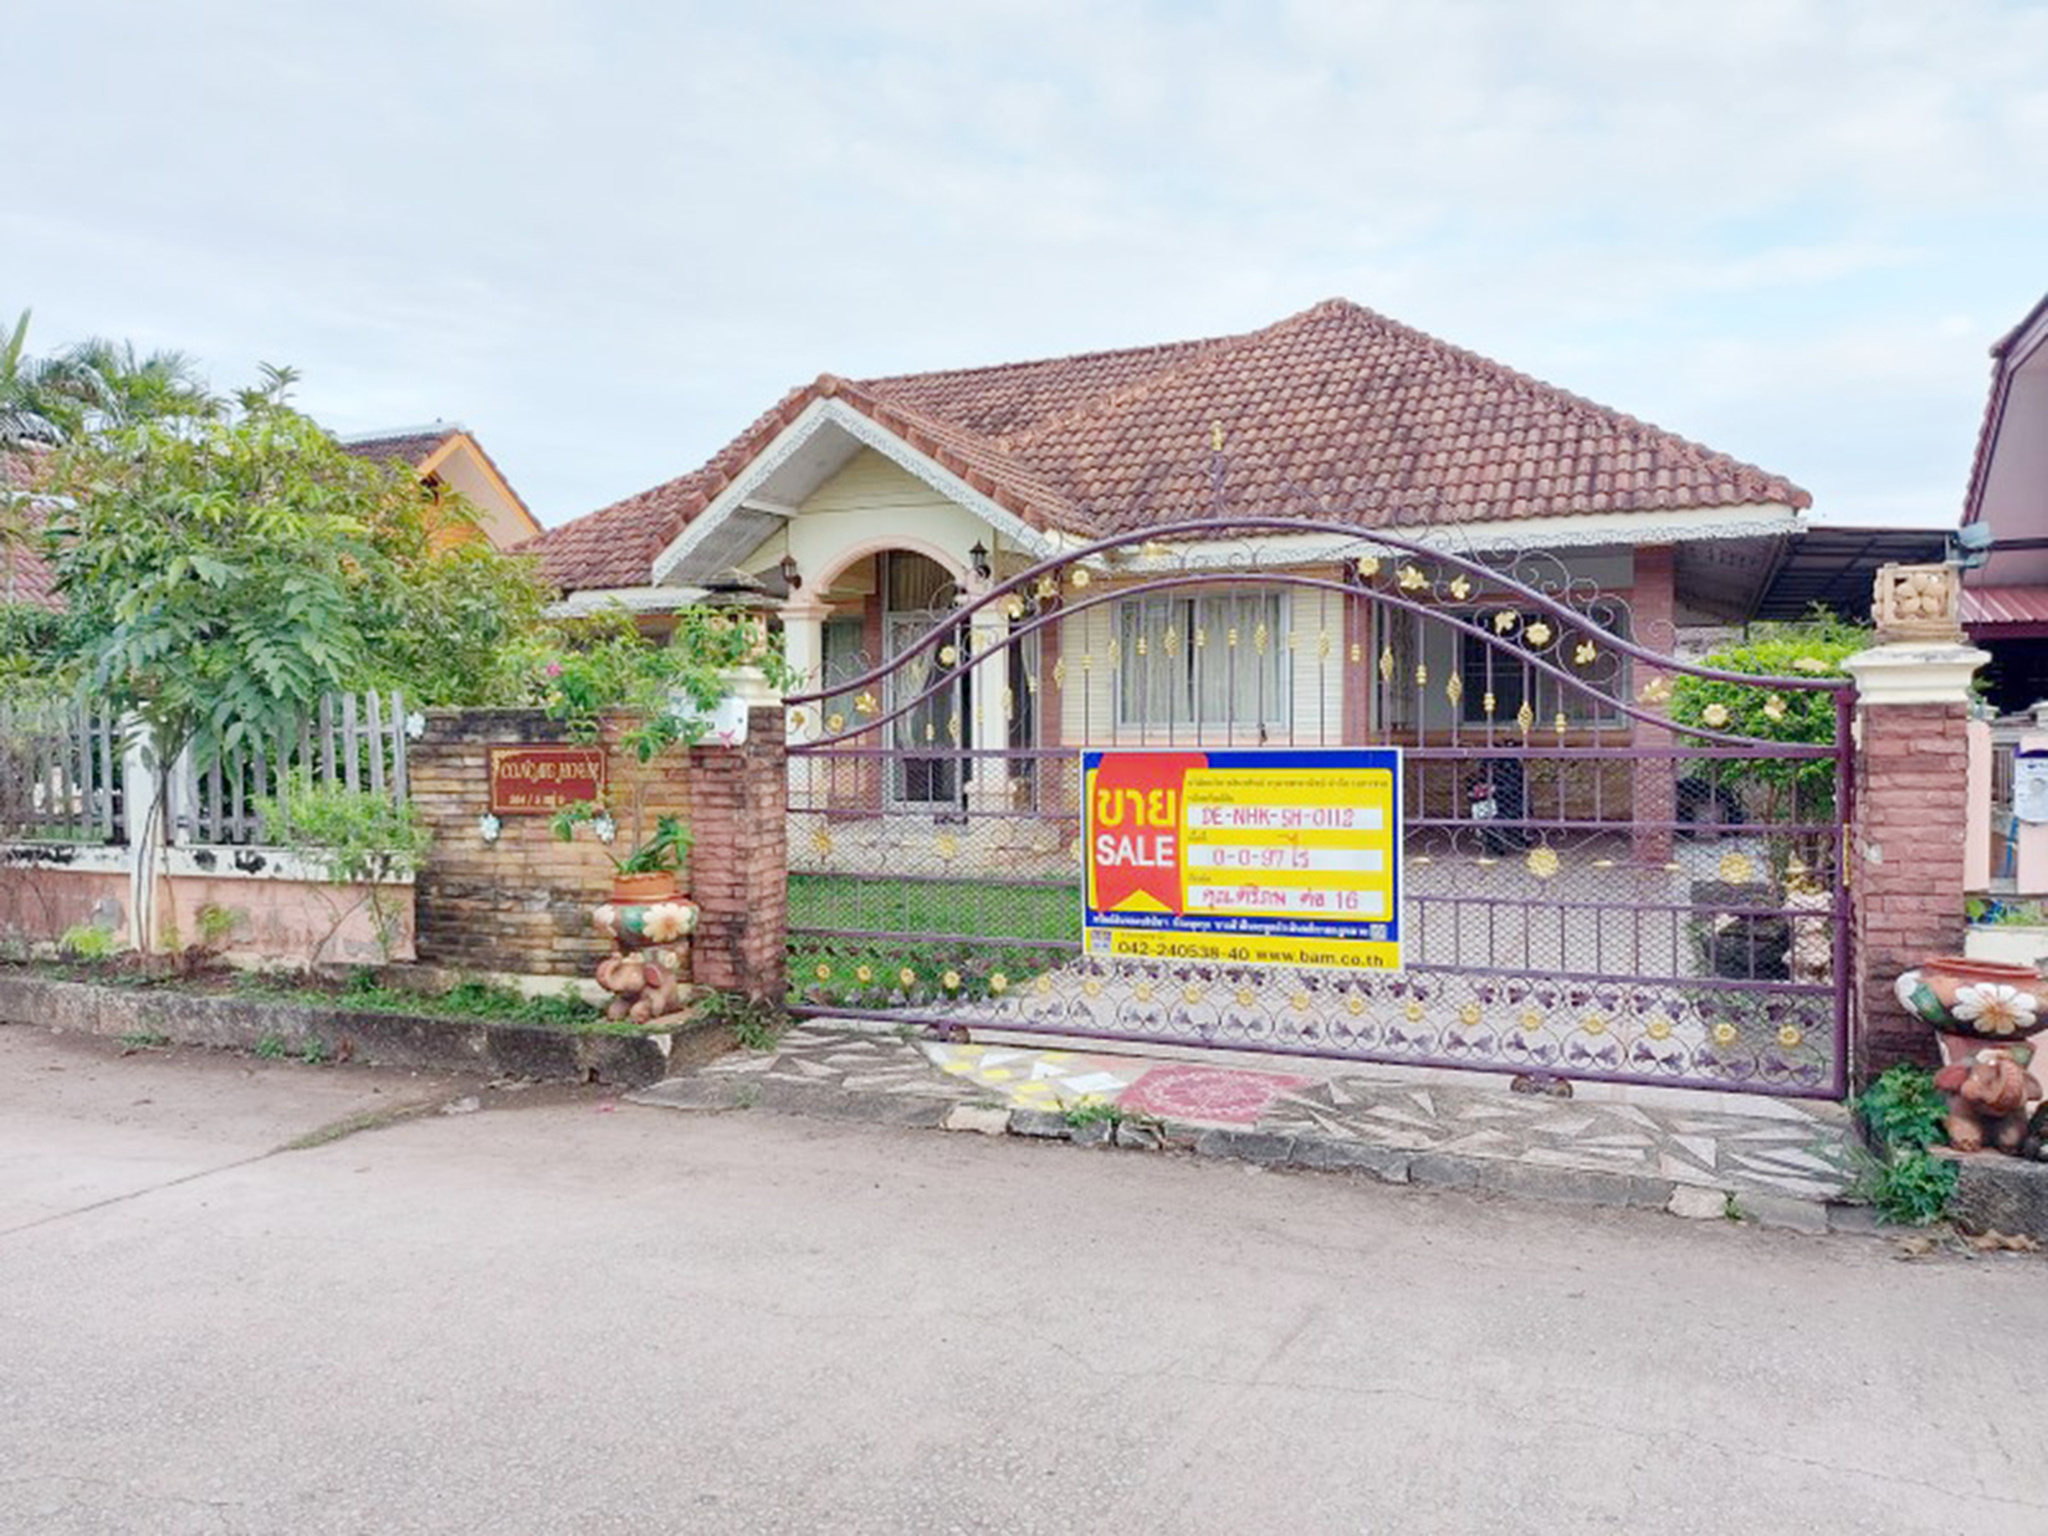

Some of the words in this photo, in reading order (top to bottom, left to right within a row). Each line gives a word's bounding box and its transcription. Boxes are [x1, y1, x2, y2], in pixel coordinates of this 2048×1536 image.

[1098, 788, 1176, 827] ขาย
[1096, 834, 1175, 867] SALE
[1336, 890, 1359, 909] 16
[1117, 941, 1250, 961] 042-240538-40
[1255, 943, 1385, 967] www.bam.co.th
